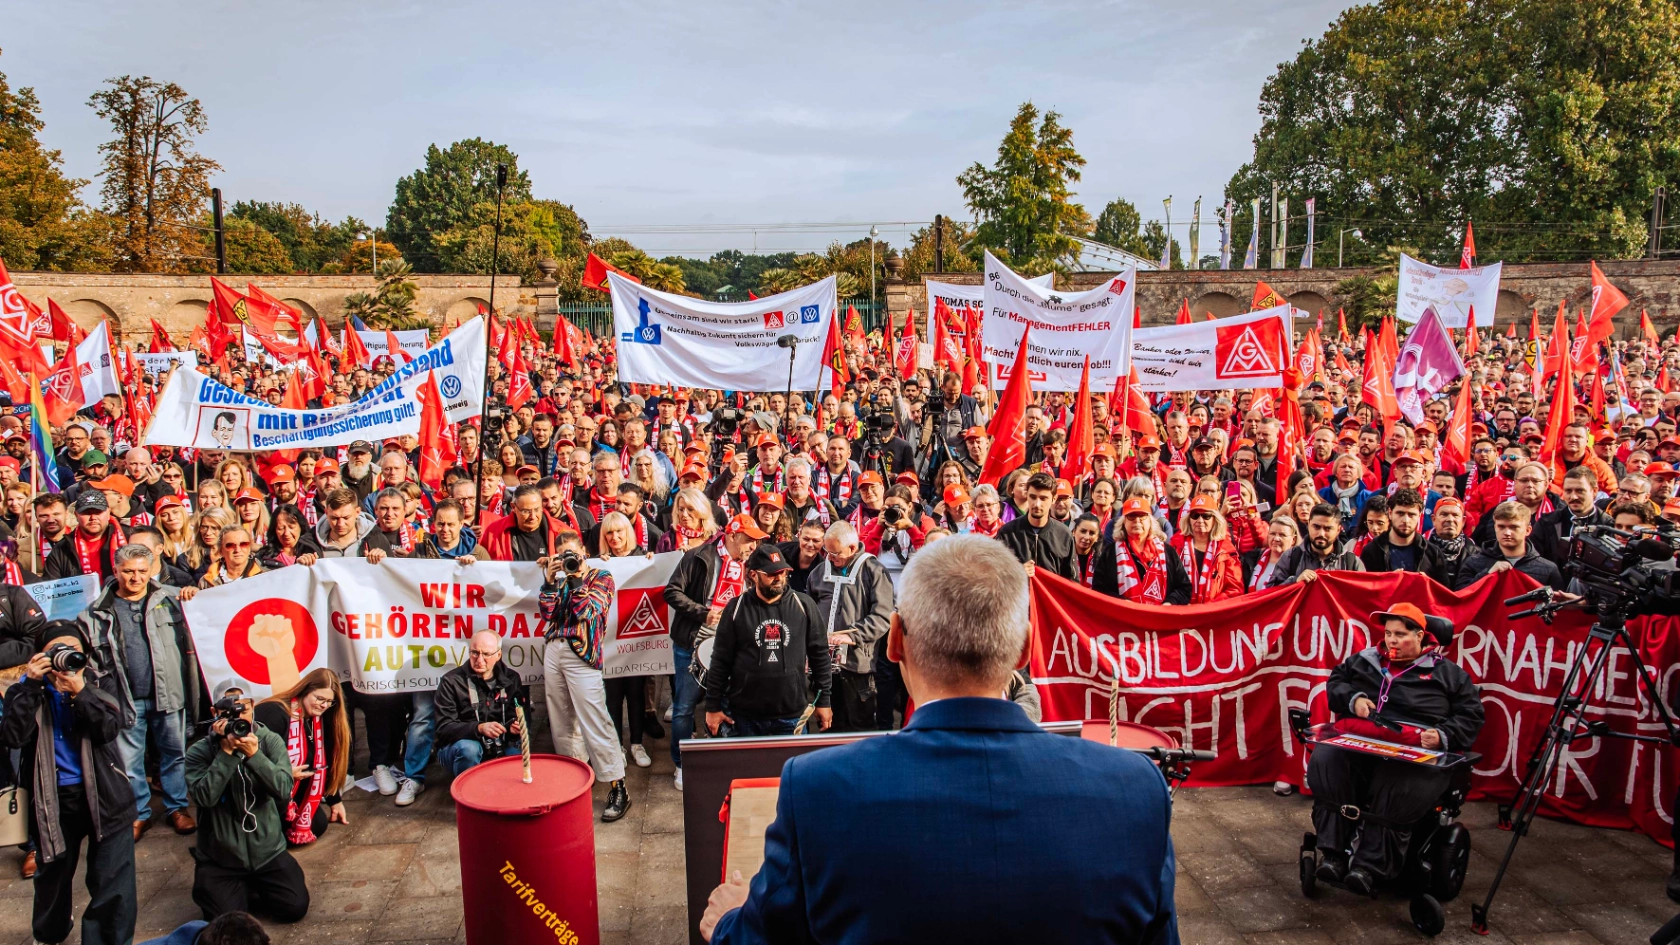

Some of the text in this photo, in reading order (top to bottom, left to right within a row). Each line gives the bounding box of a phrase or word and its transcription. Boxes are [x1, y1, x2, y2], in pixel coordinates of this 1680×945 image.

[995, 281, 1021, 299] Durch
[1022, 294, 1035, 304] die
[1080, 297, 1113, 312] gesagt:
[701, 316, 718, 324] sind
[734, 316, 759, 325] stark!
[992, 306, 1008, 318] Für
[666, 325, 707, 338] Nachhaltig
[737, 332, 765, 340] sichern
[1014, 338, 1083, 357] knnen wir nix.
[1165, 347, 1182, 355] oder
[984, 345, 1015, 360] Macht
[1054, 362, 1084, 370] euren
[1168, 357, 1187, 365] sind
[1188, 360, 1202, 368] wir
[1143, 366, 1179, 378] stärker!
[252, 401, 416, 448] Beschäftigungssicherung gilt!
[257, 412, 298, 430] mit
[420, 582, 487, 609] WIR
[331, 606, 547, 640] GEHÖREN DAZ
[617, 639, 669, 655] WOLFSBURG
[1048, 622, 1283, 684] AUSBILDUNG
[1293, 612, 1372, 662] UND
[604, 661, 668, 676] LIDARISCH
[500, 860, 579, 945] Tarifverträge
